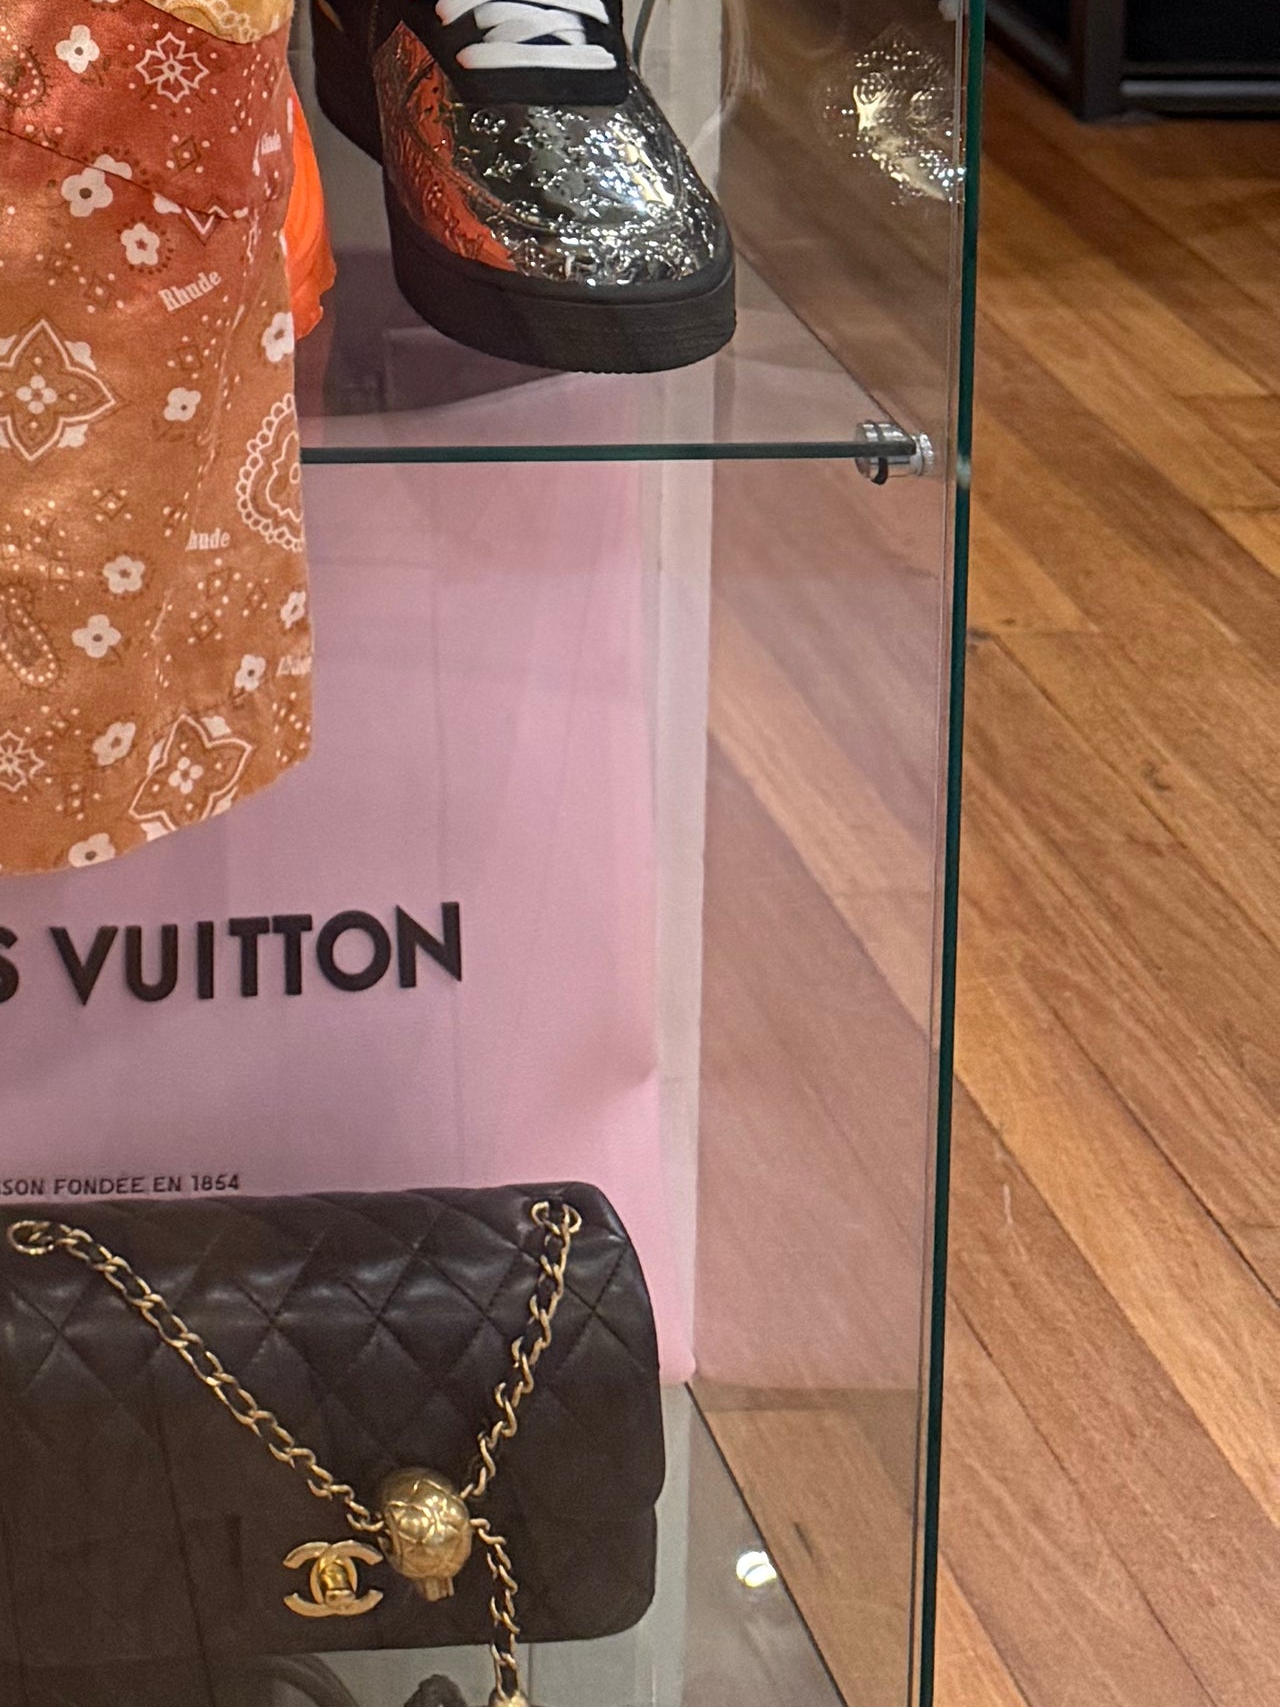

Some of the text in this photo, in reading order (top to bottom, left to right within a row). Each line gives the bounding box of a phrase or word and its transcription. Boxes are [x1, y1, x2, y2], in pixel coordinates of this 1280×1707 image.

[160, 270, 221, 312] Rhude
[50, 902, 463, 1006] VUITTON
[152, 1175, 182, 1193] EN
[191, 1173, 240, 1192] 1854
